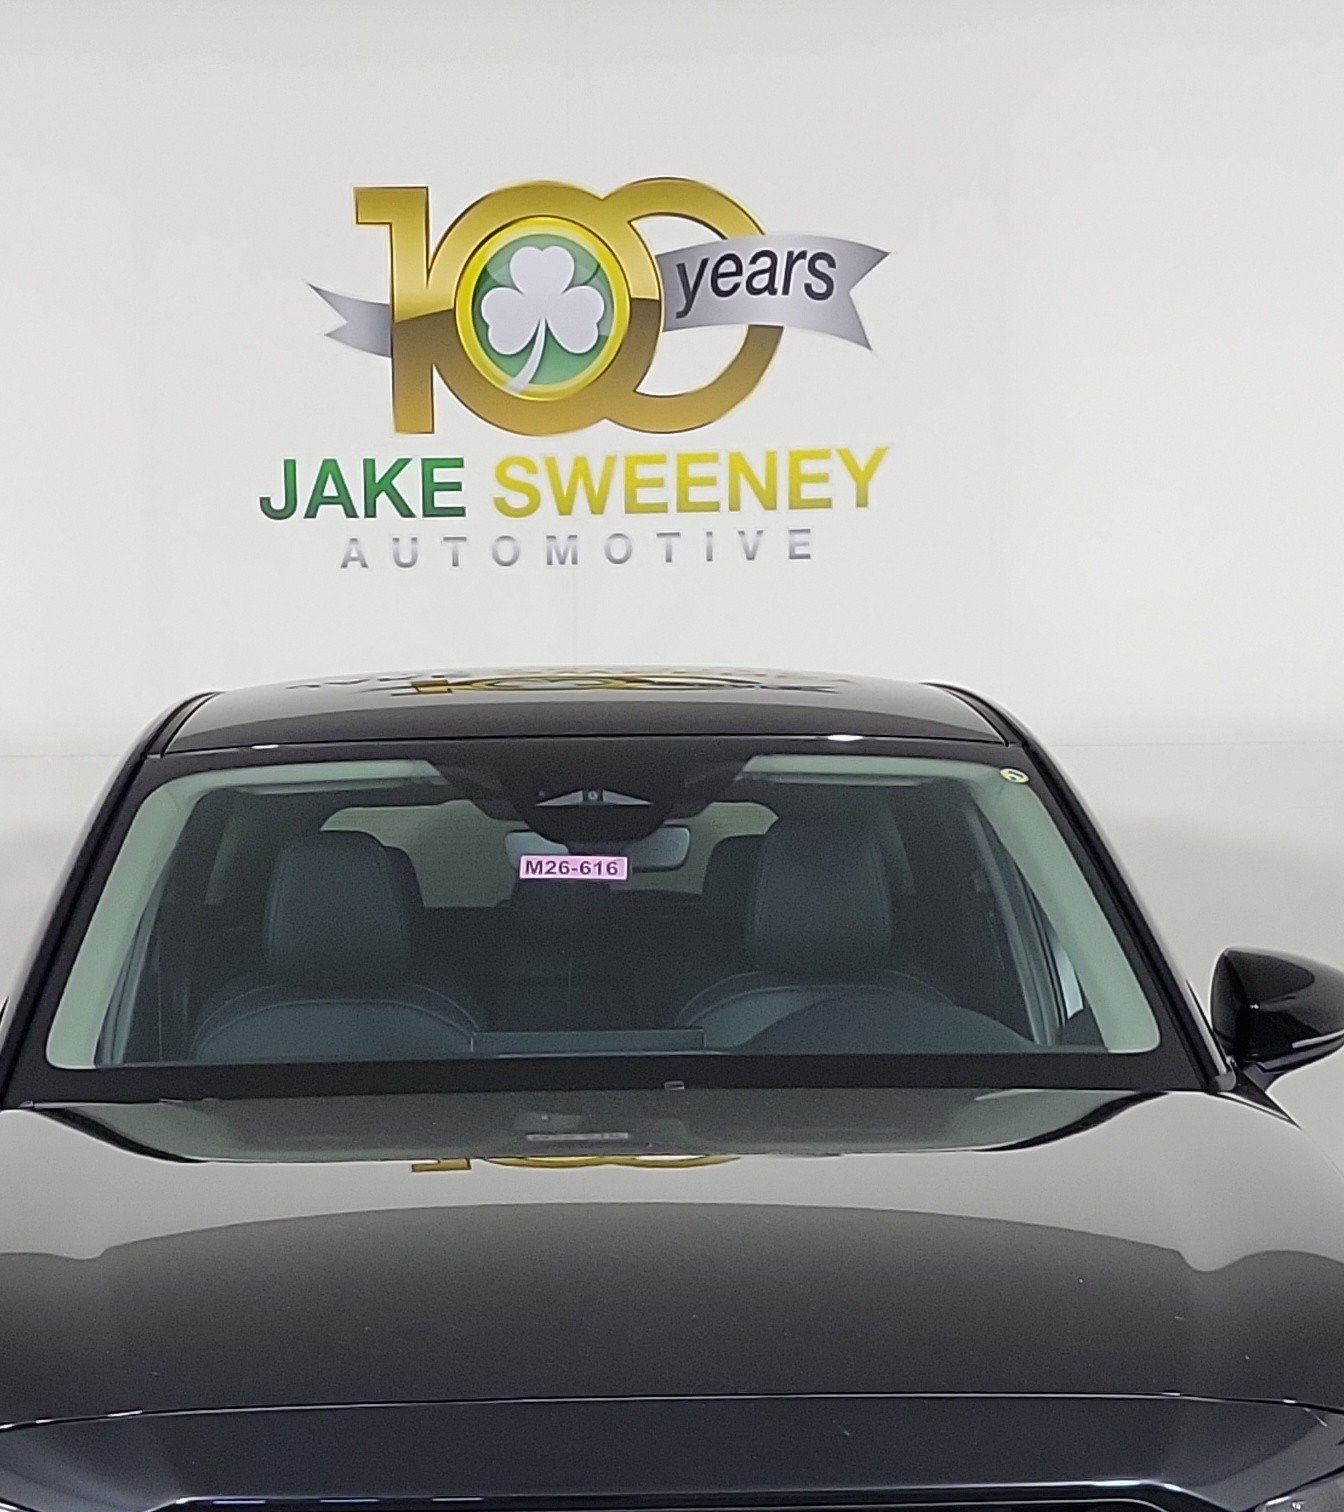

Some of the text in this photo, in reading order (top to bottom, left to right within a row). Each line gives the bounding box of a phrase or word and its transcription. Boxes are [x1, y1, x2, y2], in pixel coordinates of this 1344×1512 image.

[355, 177, 837, 436] 100 years
[259, 446, 889, 520] JAKE SWEENEY
[340, 529, 812, 568] AUTOMOTIVE
[525, 860, 618, 875] M26-616
